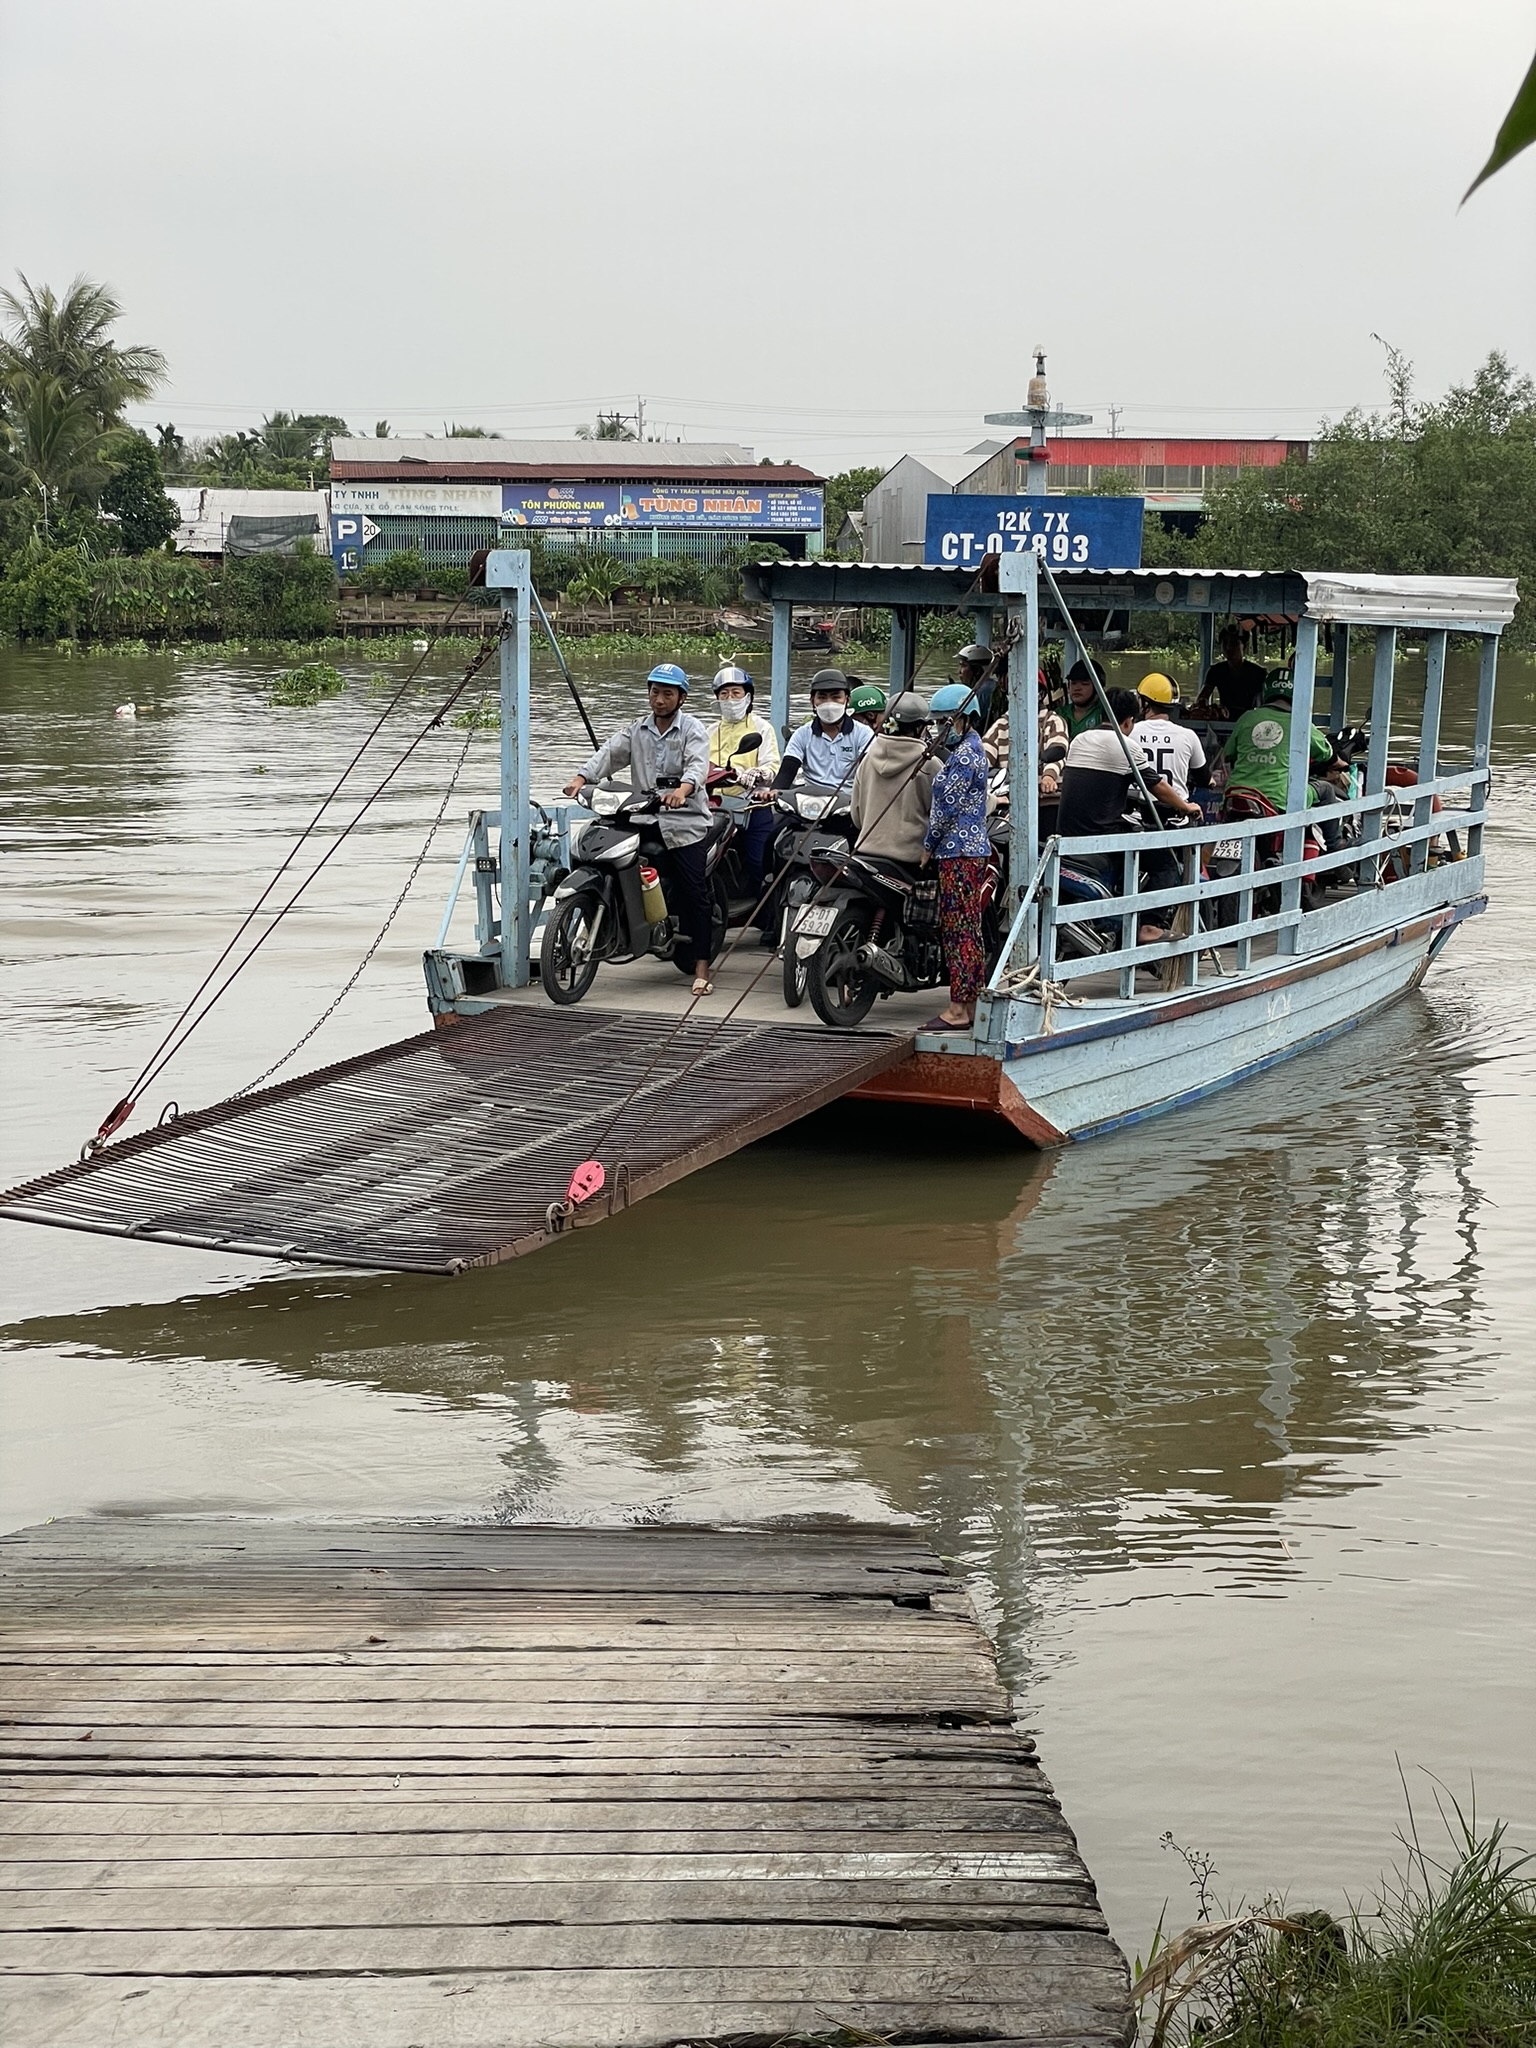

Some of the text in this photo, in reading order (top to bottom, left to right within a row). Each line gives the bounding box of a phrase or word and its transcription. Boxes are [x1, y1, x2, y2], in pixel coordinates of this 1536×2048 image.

[334, 490, 347, 499] TY
[351, 490, 379, 499] TNHH
[521, 499, 605, 510] TÔN PHƯƠNG NAM
[639, 494, 762, 513] TÙNG NHÂN
[997, 511, 1070, 533] 12K 7X
[337, 520, 358, 540] P
[363, 525, 376, 536] 20
[1271, 680, 1294, 689] Grab
[857, 697, 877, 707] Grab
[1246, 751, 1277, 765] Grab
